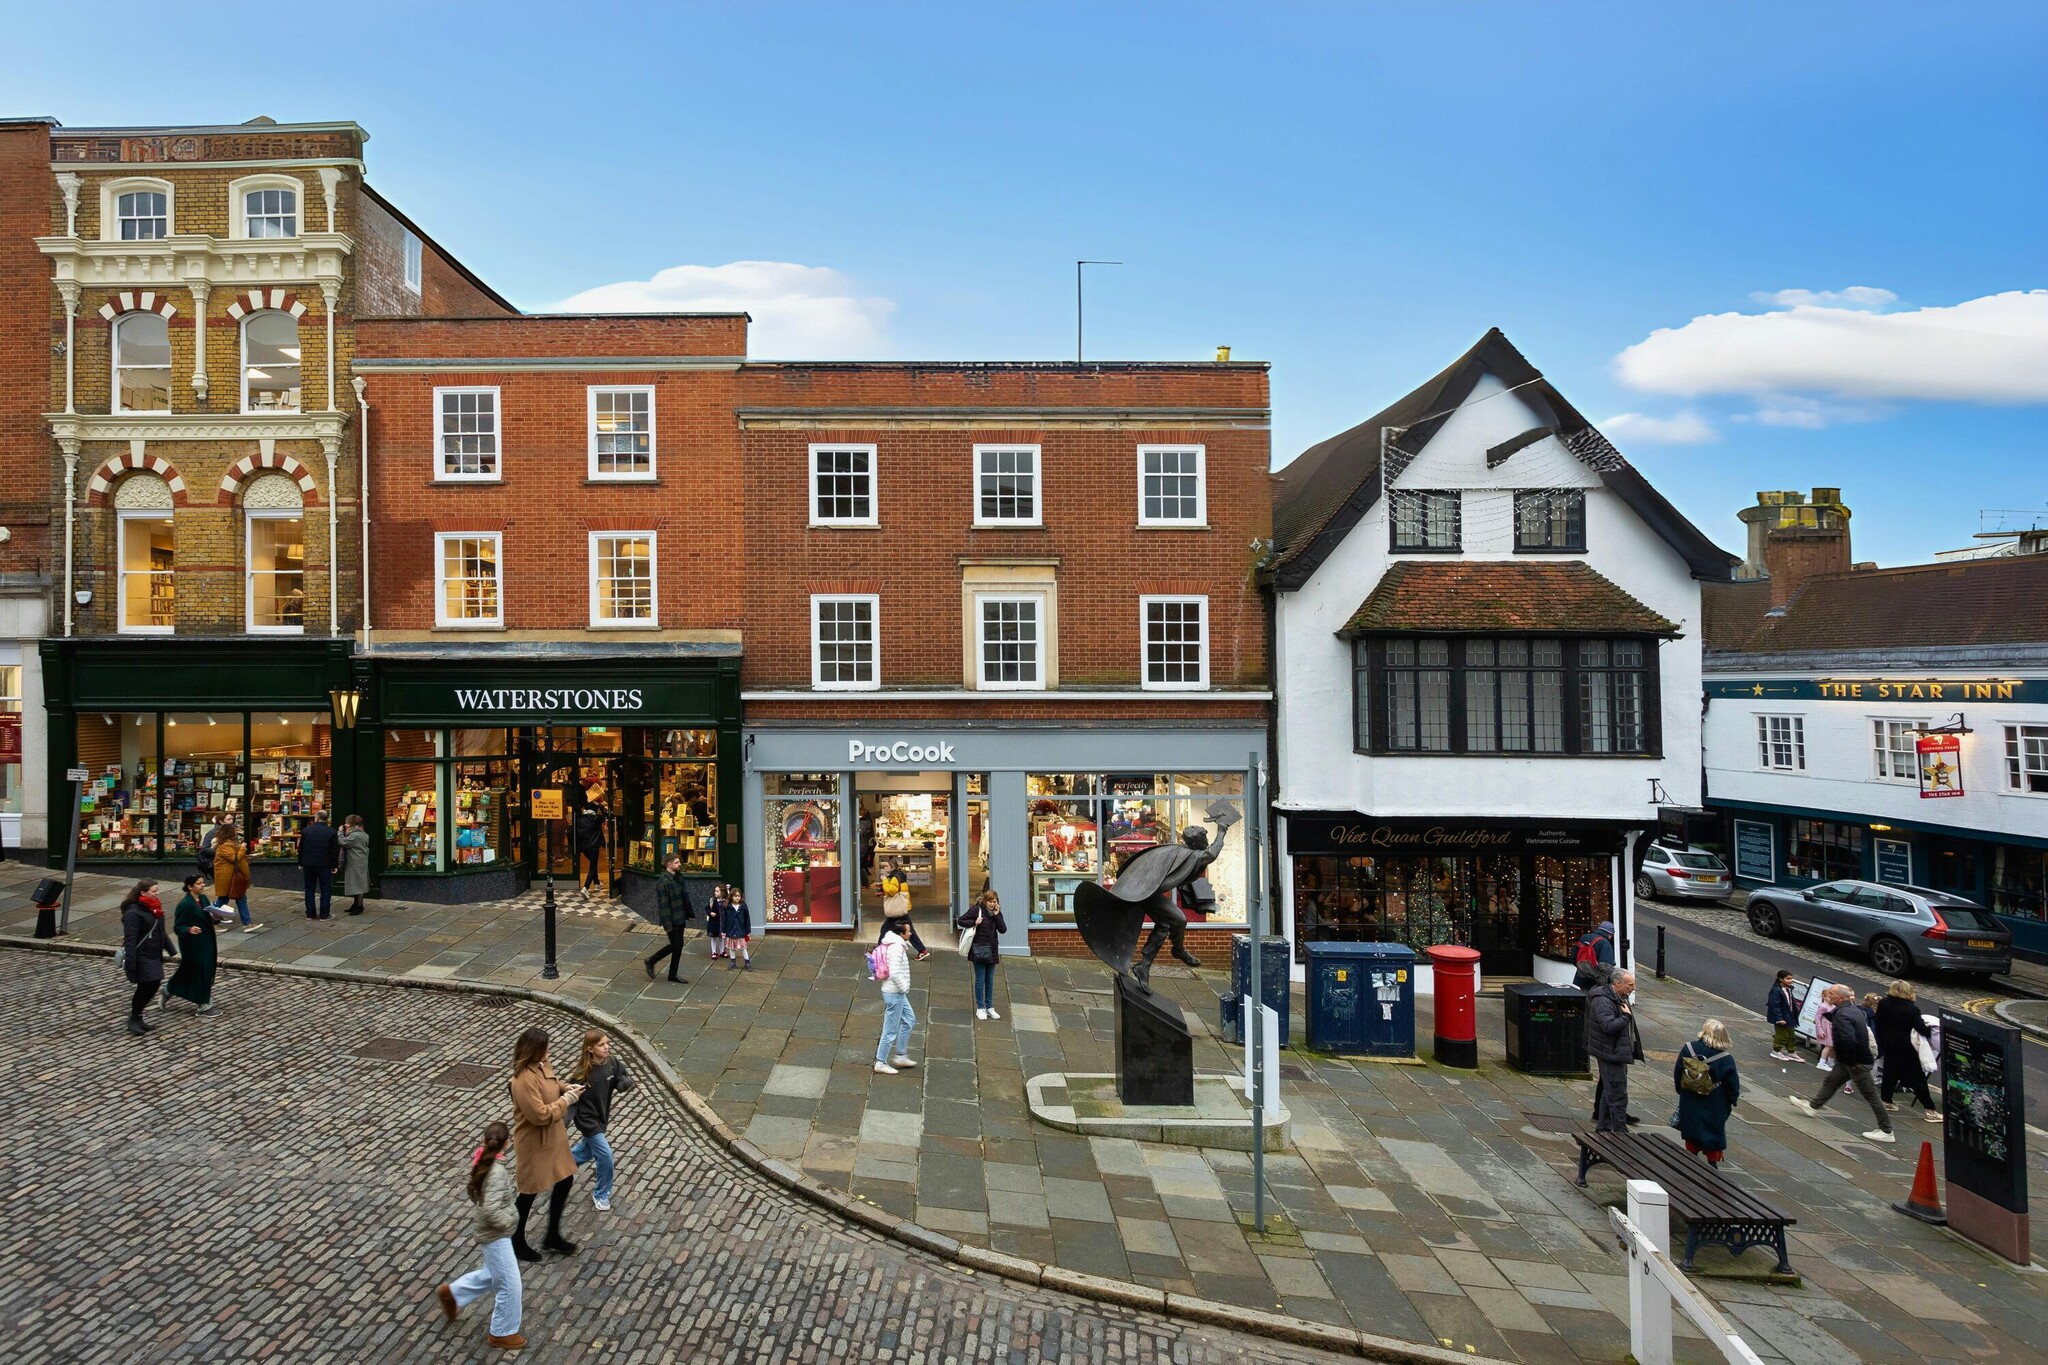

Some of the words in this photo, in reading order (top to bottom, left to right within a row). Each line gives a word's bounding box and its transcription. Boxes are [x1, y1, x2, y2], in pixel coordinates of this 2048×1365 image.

[454, 689, 643, 710] WATERSTONES
[1819, 684, 1862, 698] THE
[1878, 684, 1943, 699] STAR
[1963, 684, 2013, 699] INN
[329, 690, 361, 729] W
[848, 739, 957, 763] ProCook
[788, 786, 824, 795] Perfectly
[1330, 825, 1369, 844] Viet
[1371, 826, 1421, 847] Quan
[1423, 826, 1512, 848] Guildford
